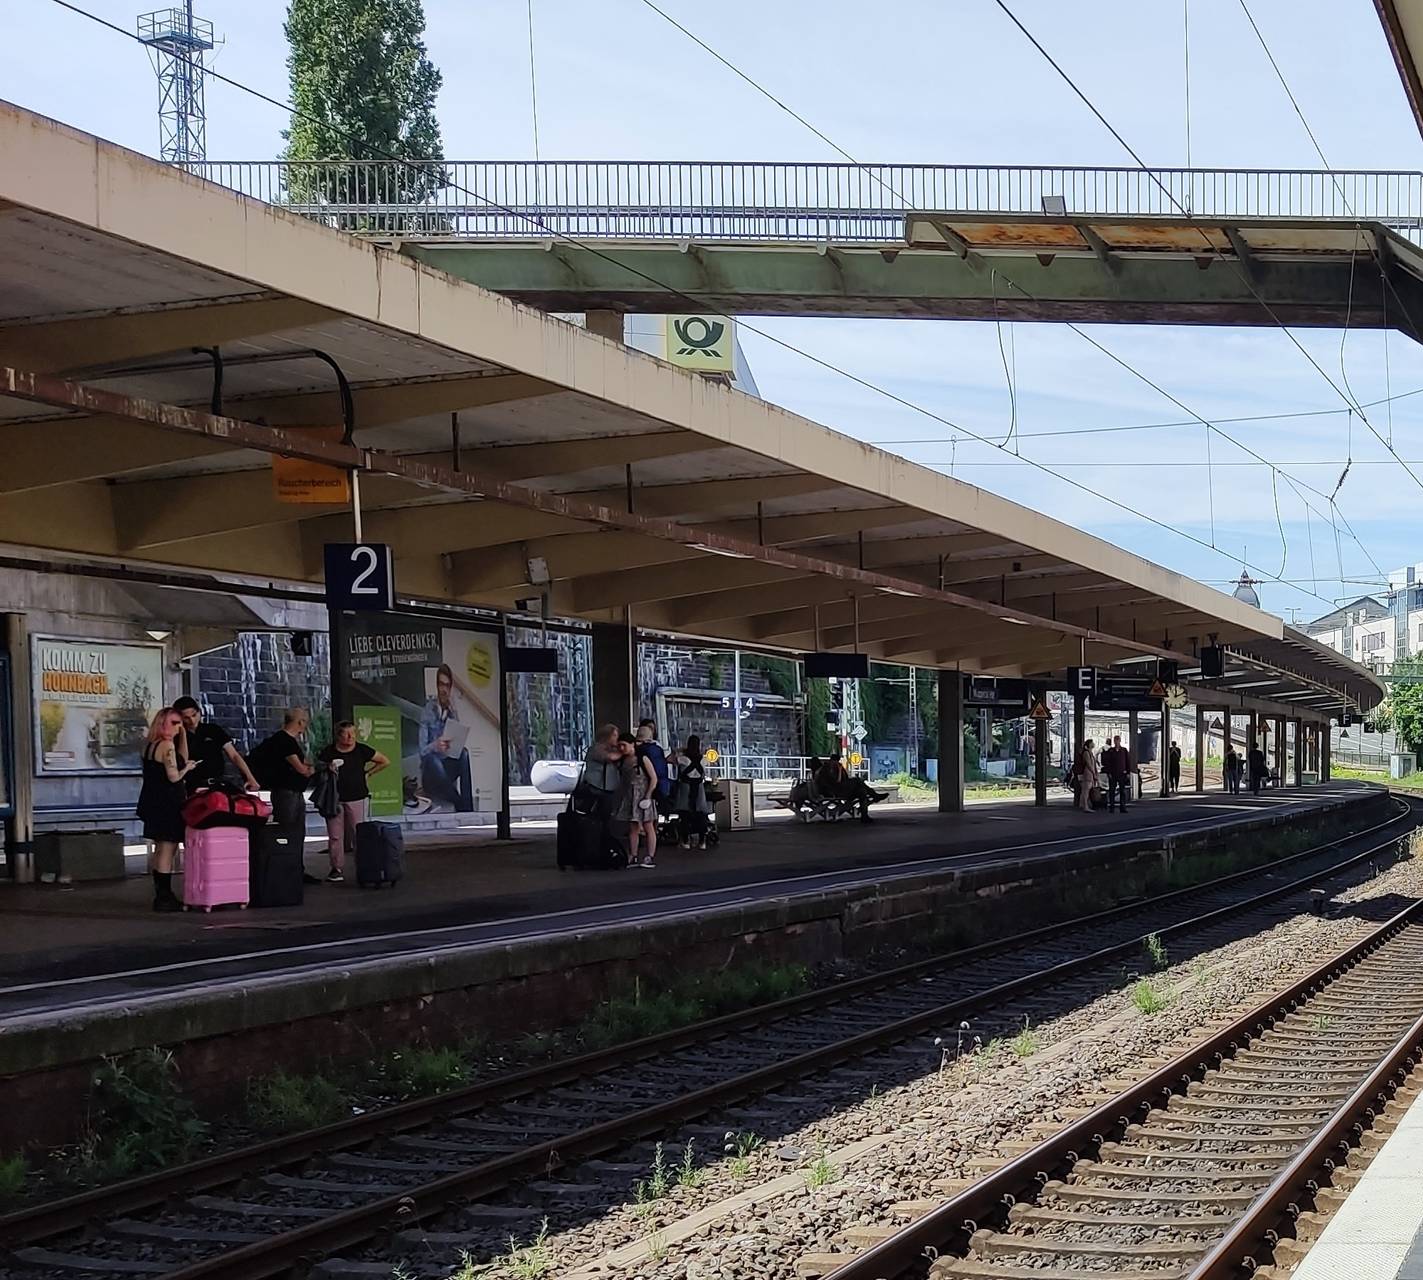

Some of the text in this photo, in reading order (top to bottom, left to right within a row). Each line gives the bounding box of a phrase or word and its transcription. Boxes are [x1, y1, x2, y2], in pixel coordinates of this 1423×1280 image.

[350, 546, 379, 594] 2
[42, 648, 107, 674] KOMM ZU
[1078, 668, 1092, 690] E
[722, 697, 730, 708] 5
[746, 697, 754, 708] 4
[1343, 714, 1351, 725] F
[1367, 722, 1375, 732] 2
